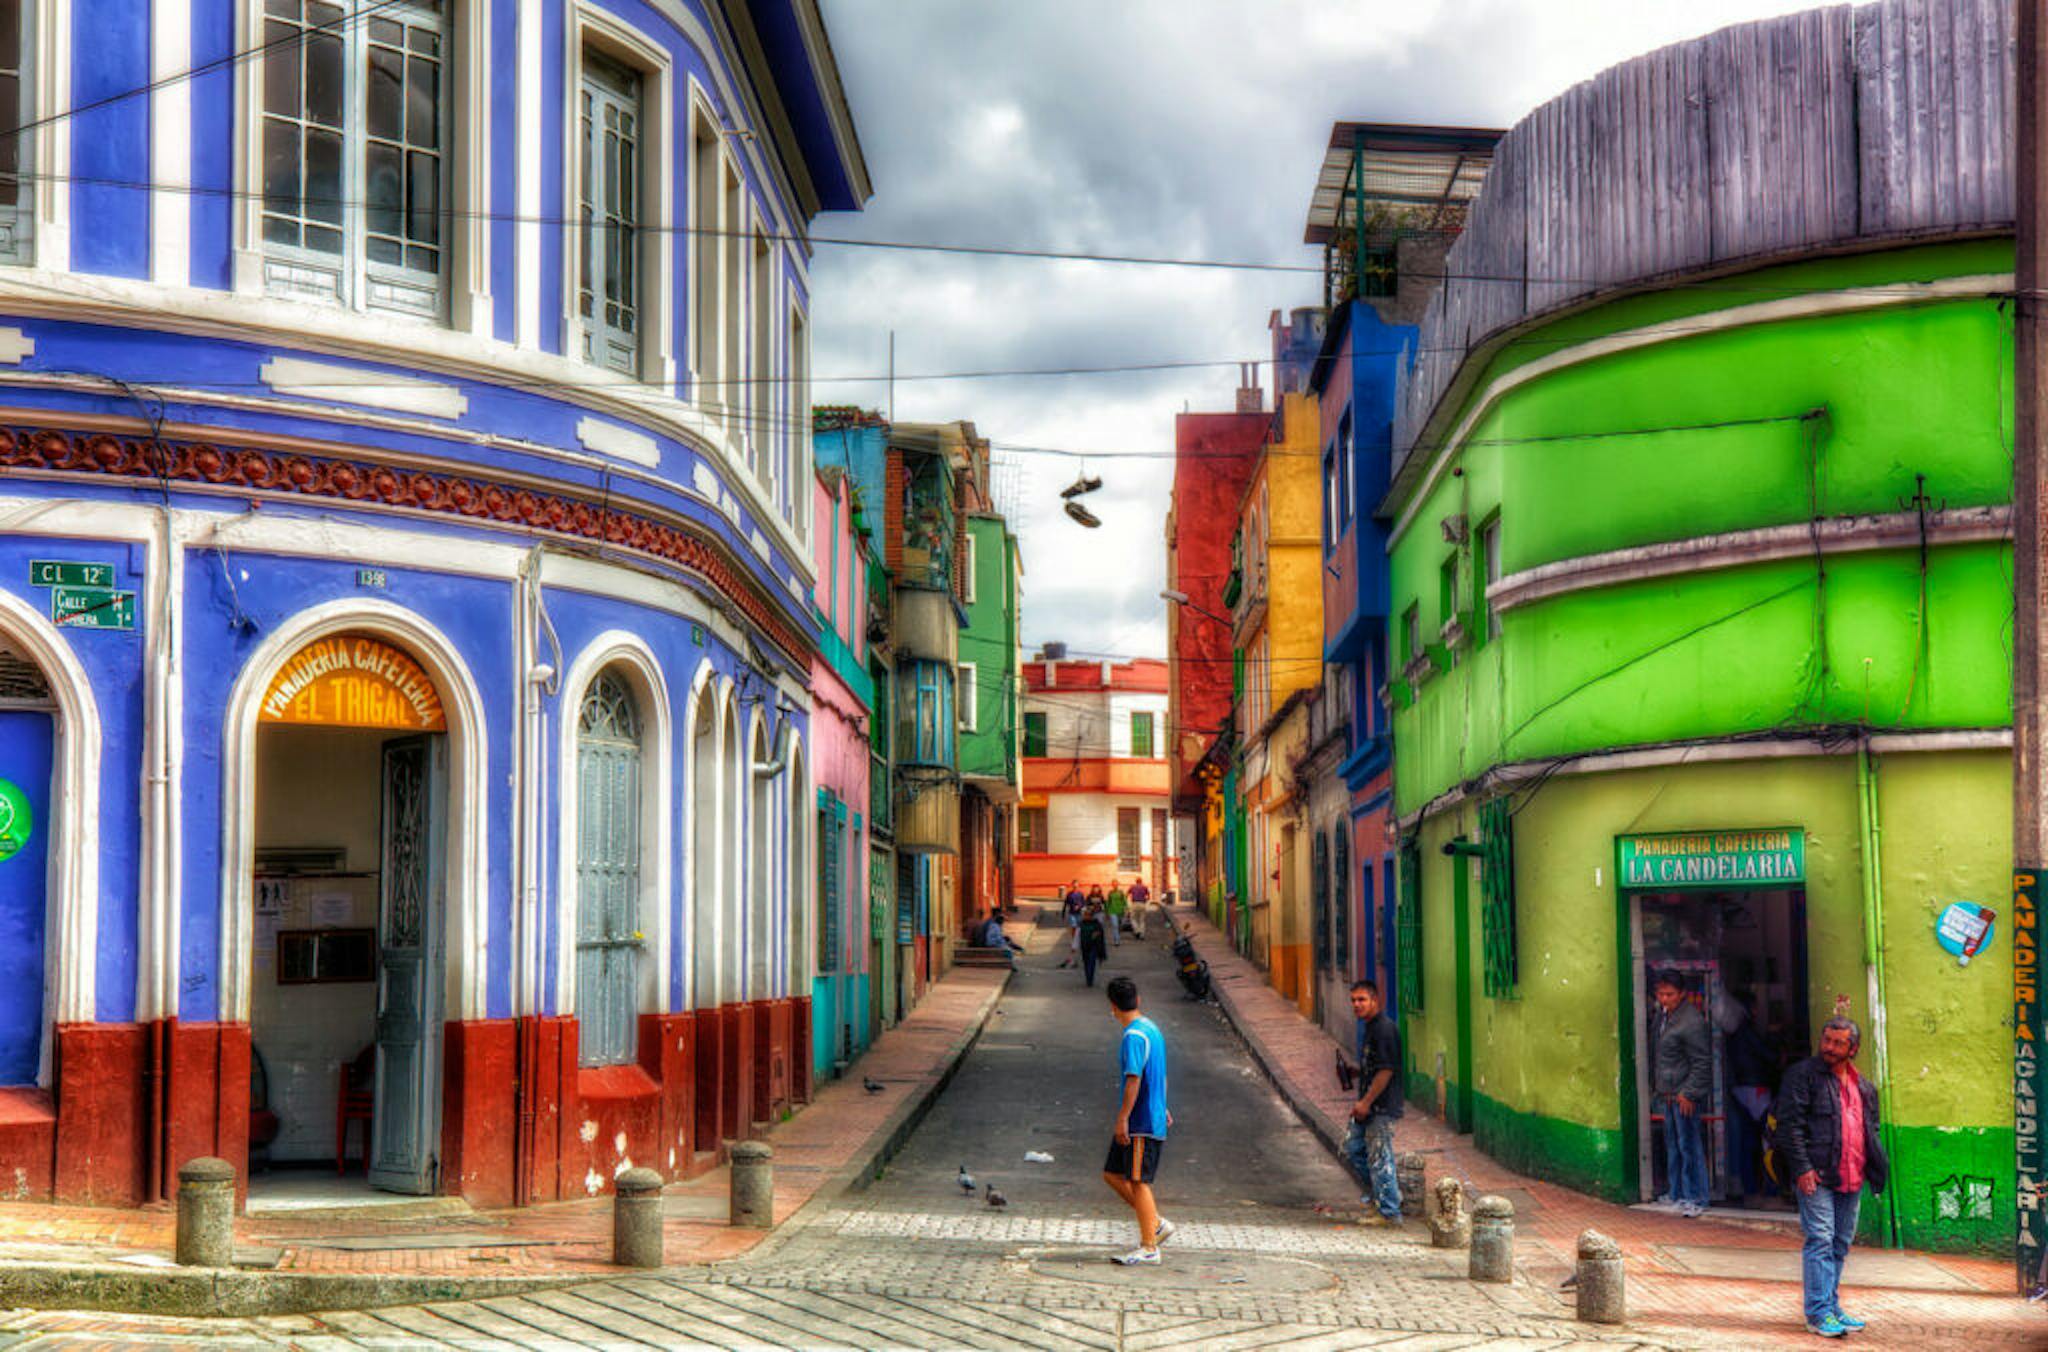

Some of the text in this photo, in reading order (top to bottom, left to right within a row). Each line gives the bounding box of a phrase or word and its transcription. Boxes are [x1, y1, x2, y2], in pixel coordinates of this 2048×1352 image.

[41, 565, 64, 583] CL
[265, 638, 442, 727] PANADERIA CAFETERIA
[294, 676, 412, 726] EL TRIGAL
[1634, 831, 1791, 857] PANADERIA CAFETERIA
[1629, 853, 1798, 884] LA CANDELARIA
[2014, 874, 2039, 1248] PANADERIA LA CANDELARIA
